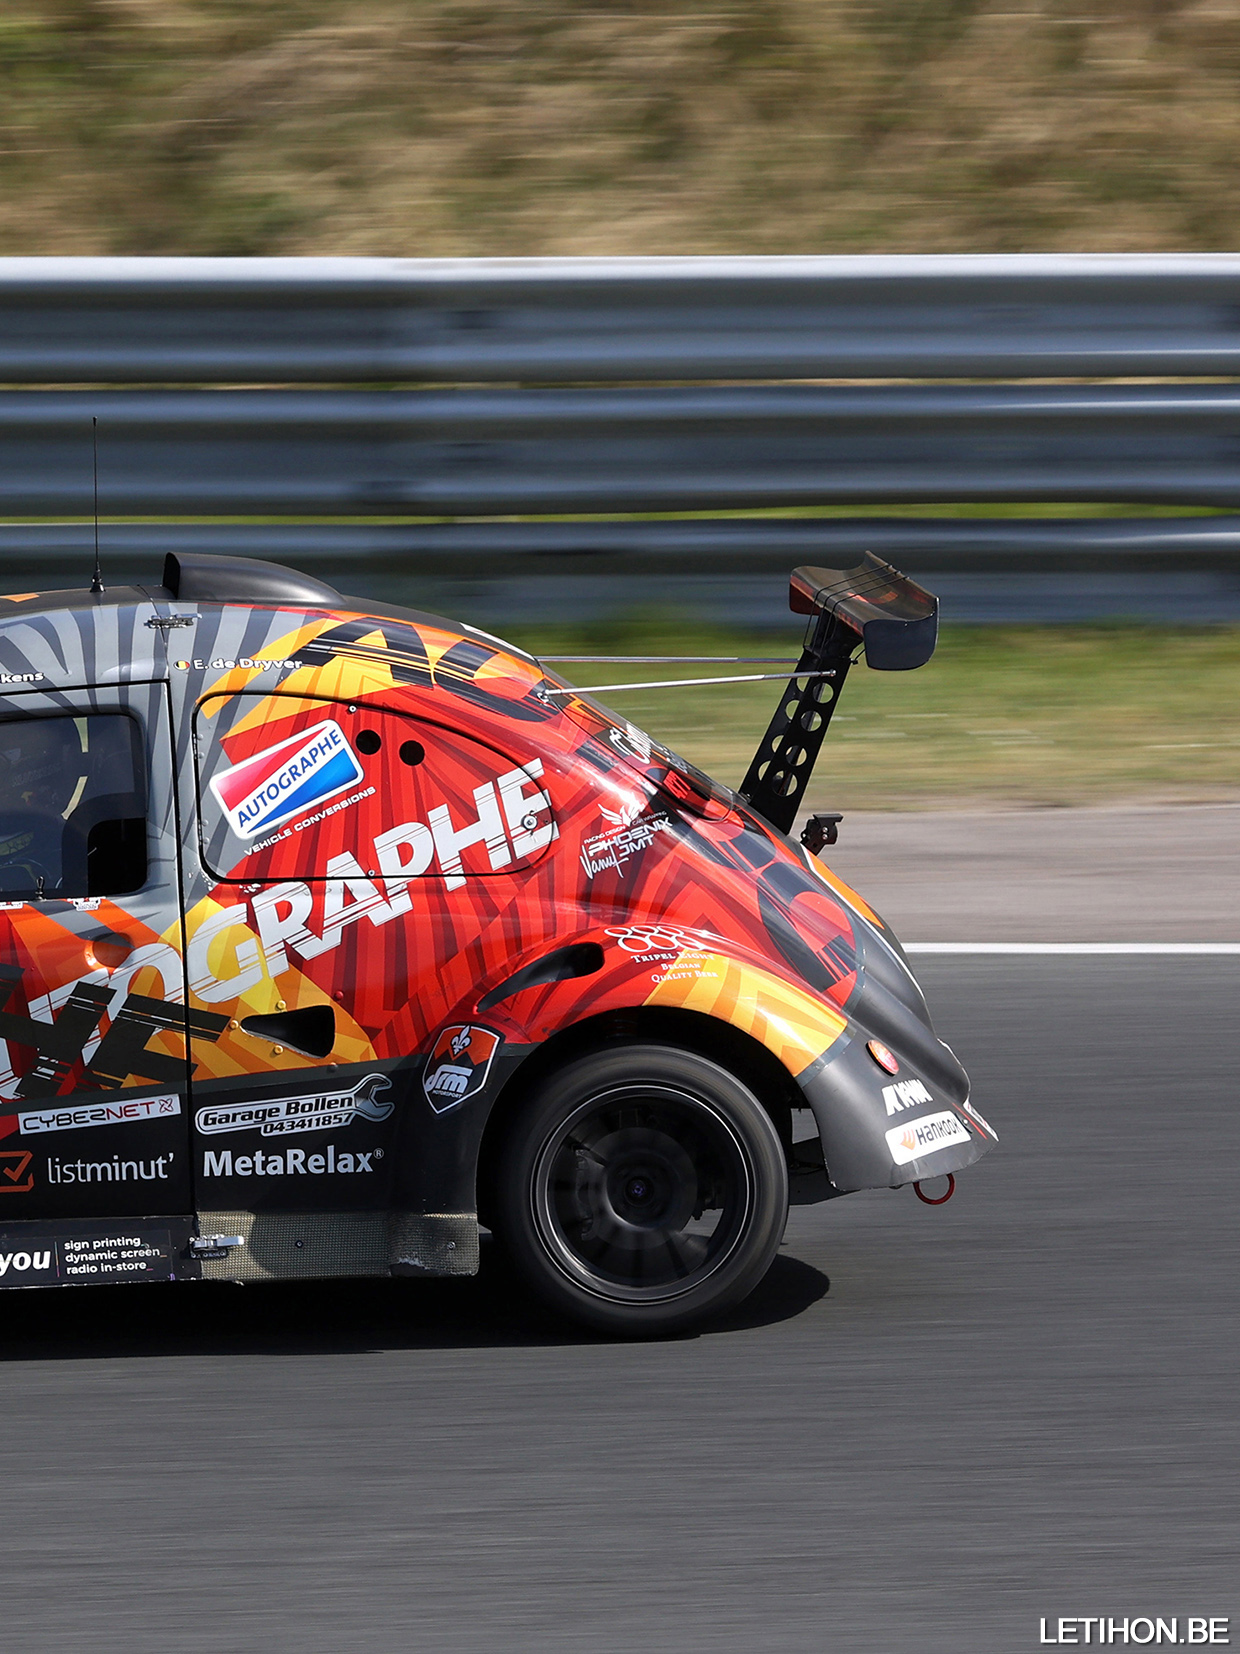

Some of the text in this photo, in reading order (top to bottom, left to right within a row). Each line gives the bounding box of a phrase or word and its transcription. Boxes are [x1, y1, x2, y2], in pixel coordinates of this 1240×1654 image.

[193, 658, 303, 673] E. de Dryver
[237, 729, 342, 828] AUTOGRAPHE
[243, 786, 377, 856] VEHICLE CONVERSIONS
[587, 816, 674, 857] PHOENIX
[203, 1095, 354, 1127] Garage Bollen
[262, 1112, 352, 1135] 043411857
[64, 1240, 90, 1252] sign
[65, 1249, 118, 1264] dynamic
[66, 1263, 98, 1275] radio
